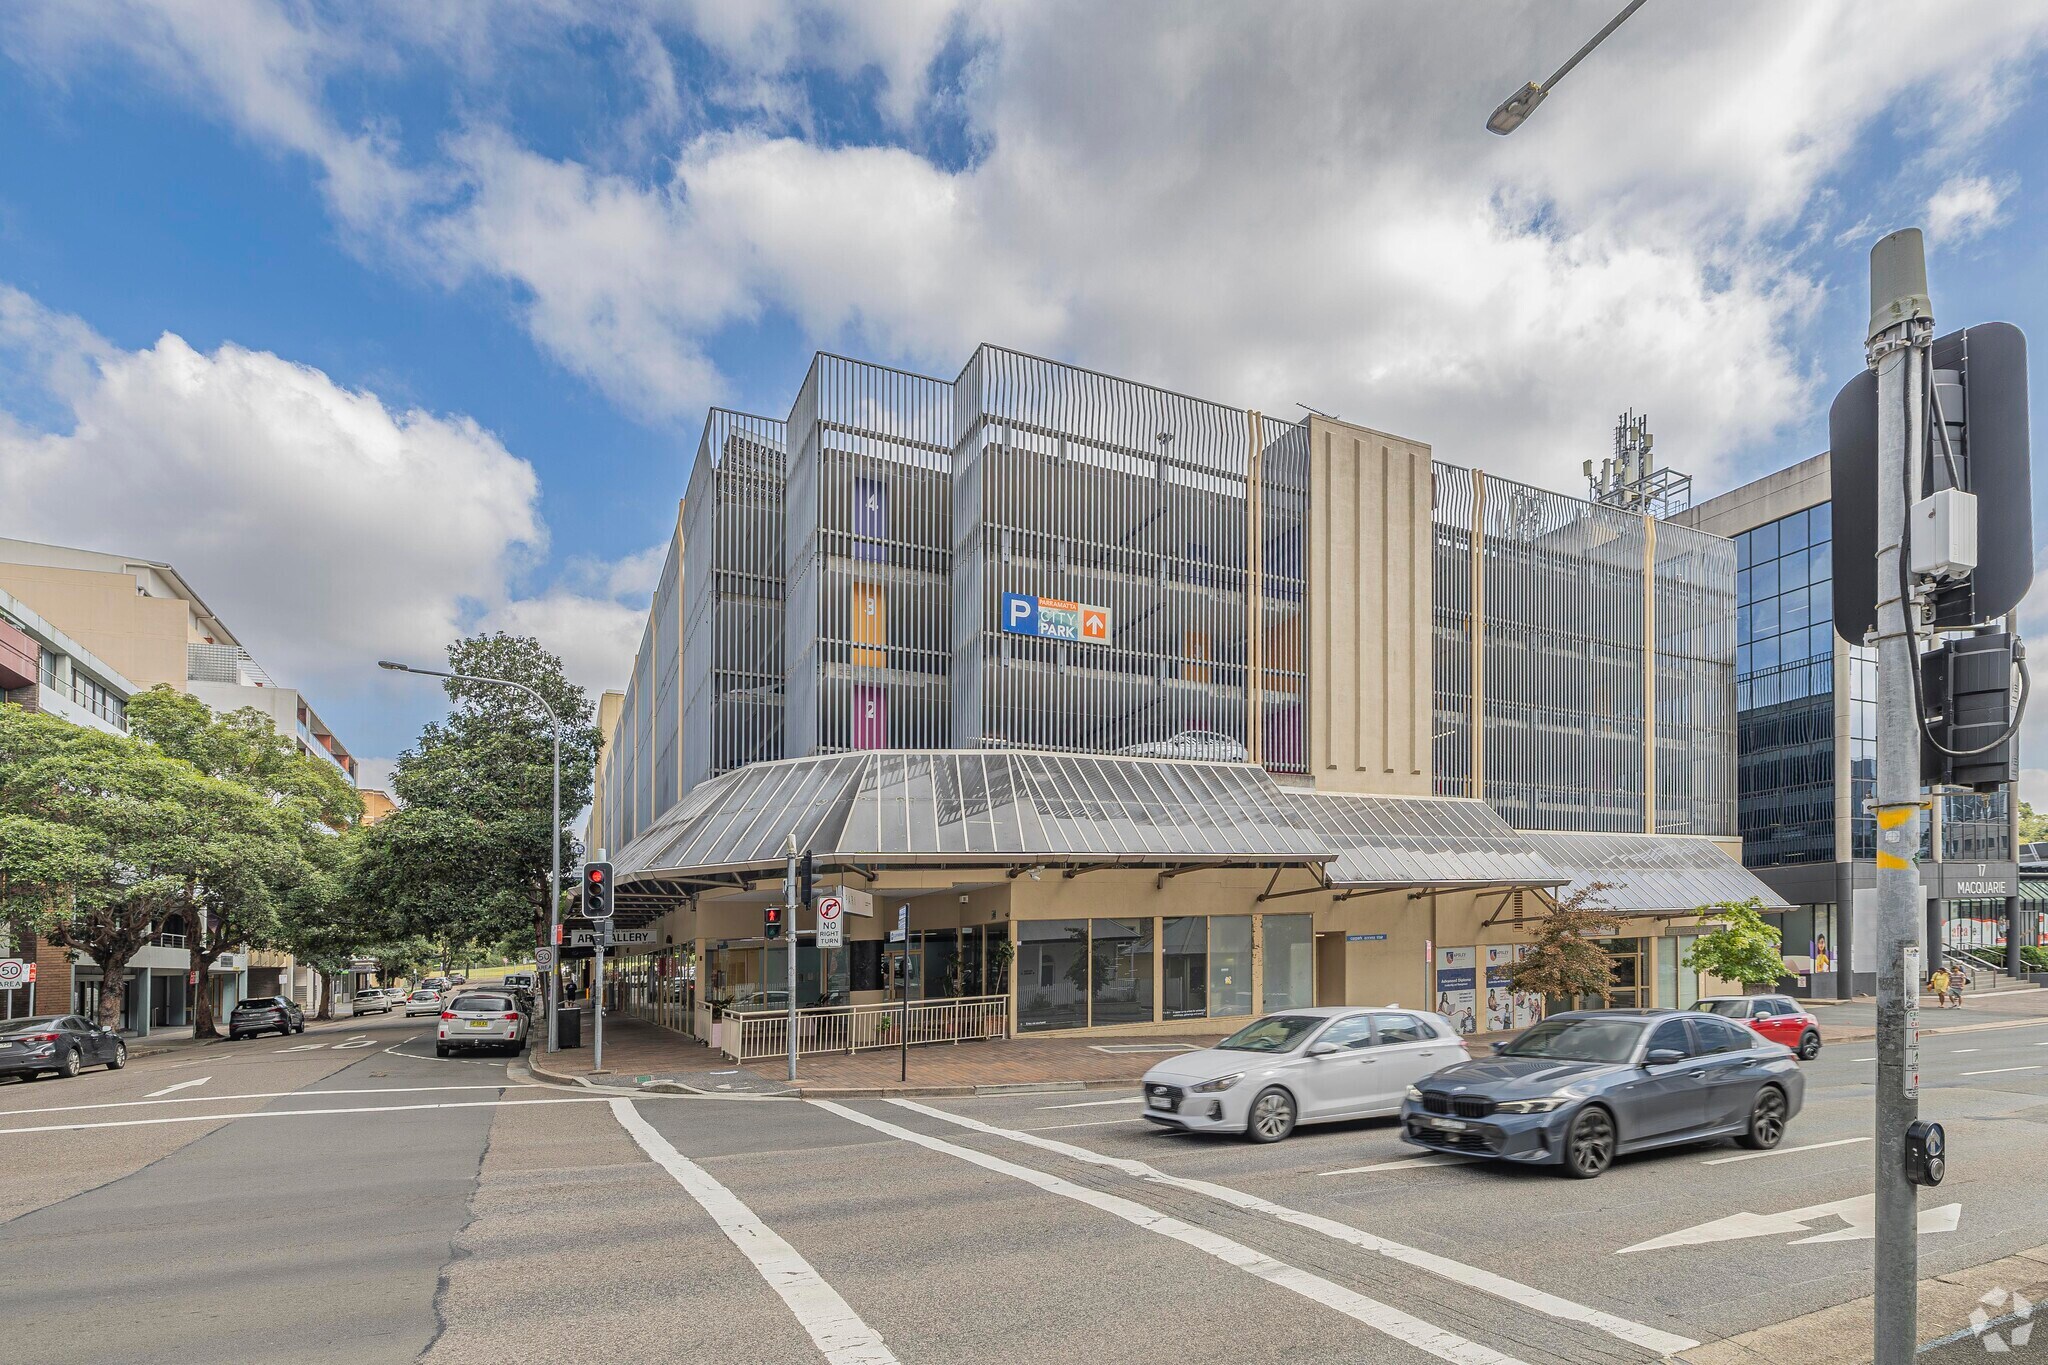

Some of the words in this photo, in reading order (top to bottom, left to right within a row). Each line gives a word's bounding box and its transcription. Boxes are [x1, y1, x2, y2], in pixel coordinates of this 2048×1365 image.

[865, 494, 879, 512] 4
[1039, 599, 1077, 611] PARRAMATTA
[1010, 599, 1031, 627] P
[1040, 610, 1076, 626] CITY
[1040, 622, 1076, 639] PARK
[1977, 864, 1986, 877] 17
[1957, 881, 2006, 894] MACQUARIE
[822, 921, 837, 930] NO
[538, 952, 550, 960] 50
[2, 966, 19, 976] 50
